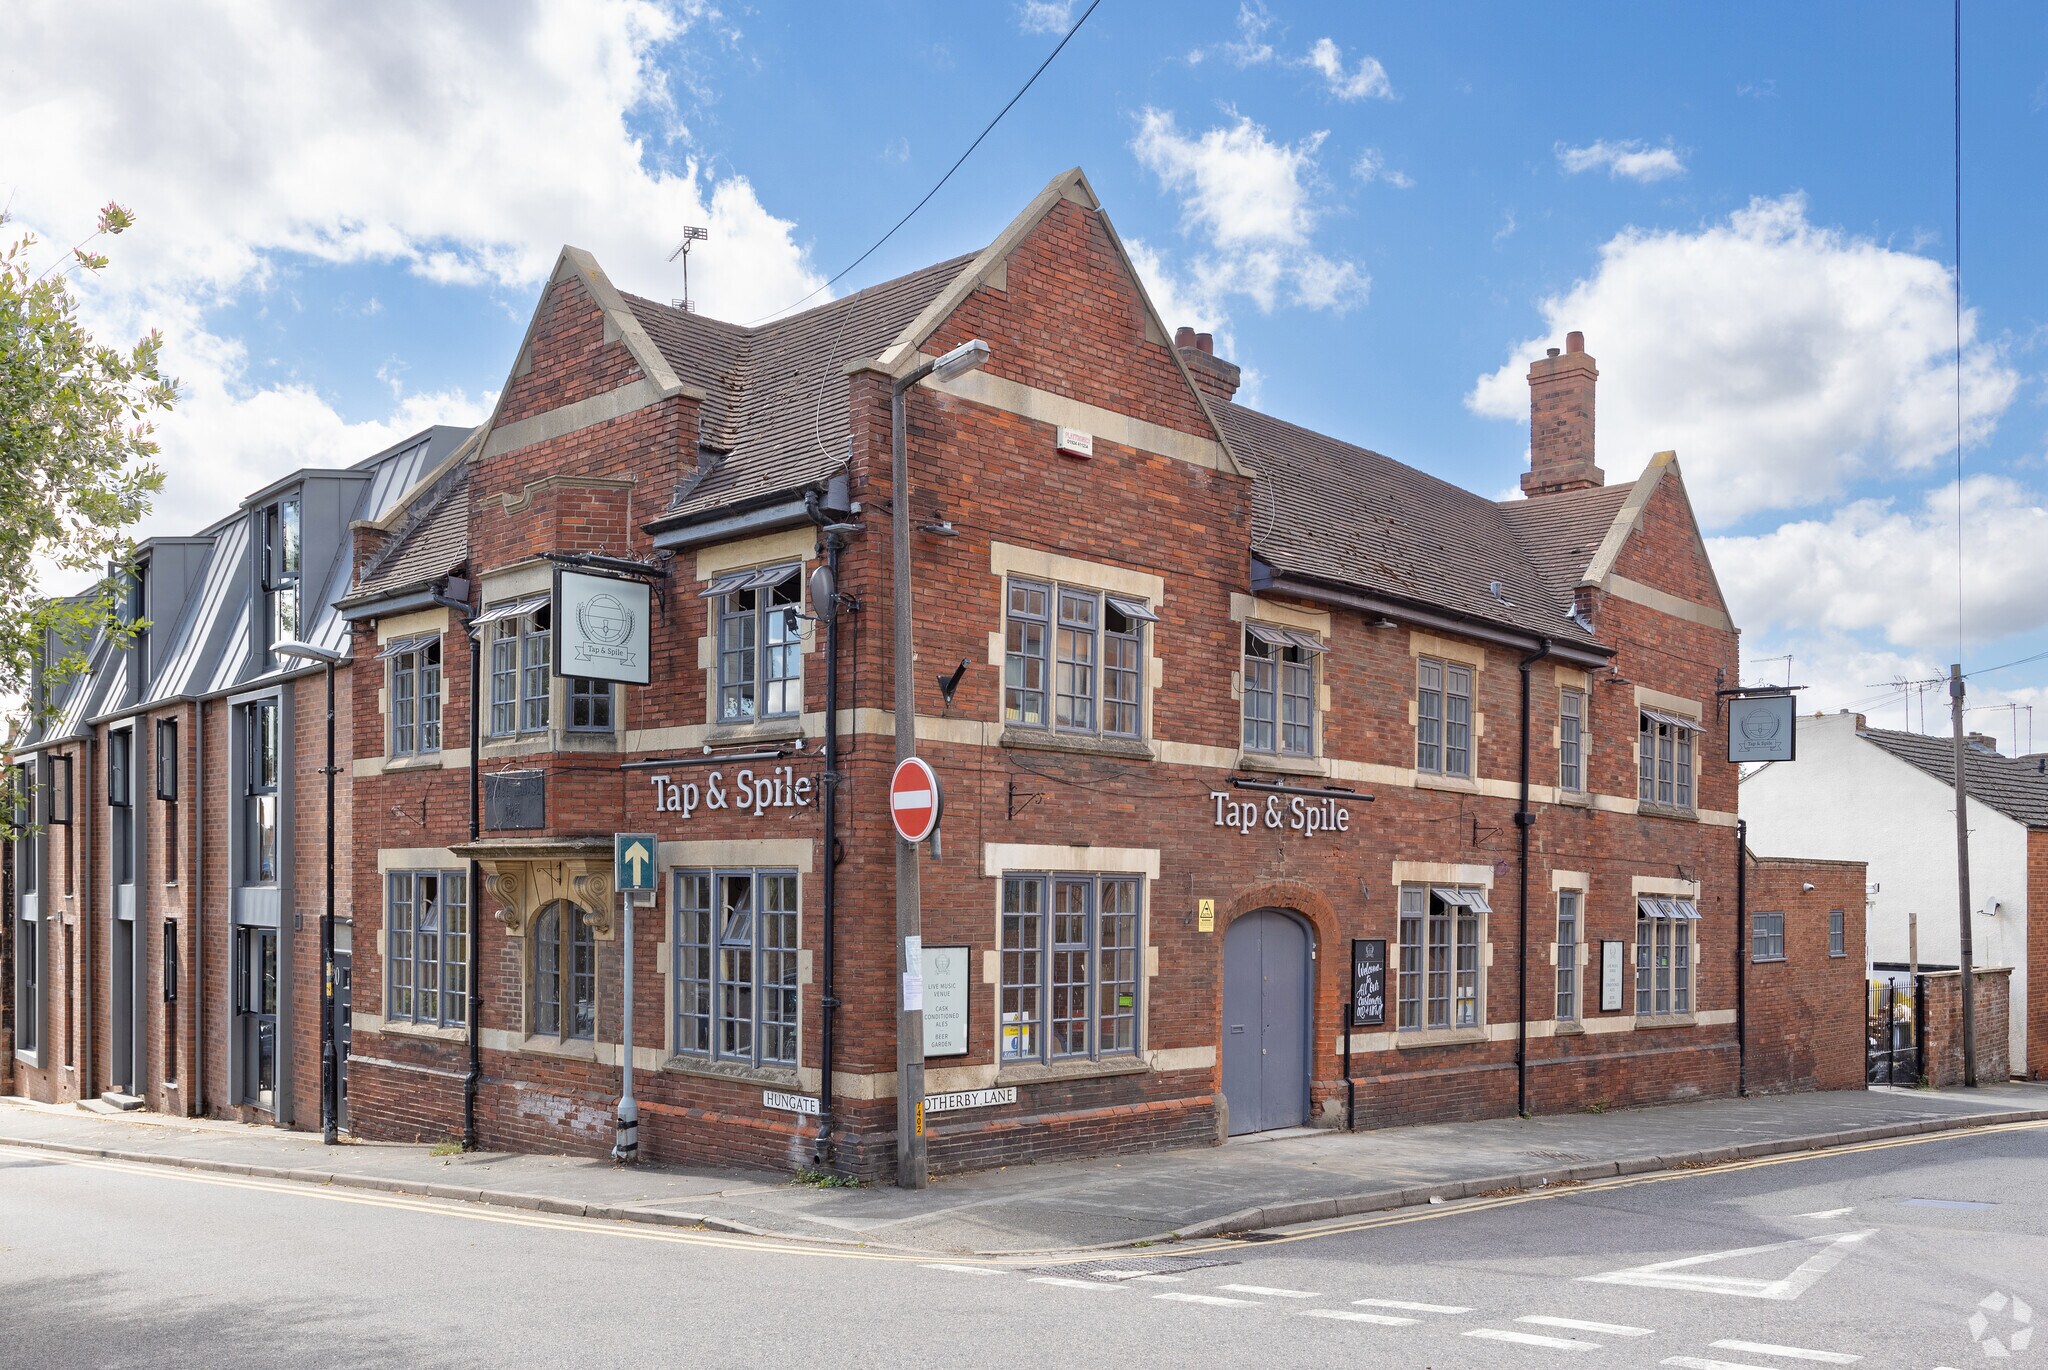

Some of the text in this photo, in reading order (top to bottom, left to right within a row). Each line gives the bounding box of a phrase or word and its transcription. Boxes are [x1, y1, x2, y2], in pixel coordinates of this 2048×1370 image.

[588, 645, 600, 655] Tap
[607, 647, 624, 656] Spile
[651, 766, 812, 819] Tap & Spile
[1209, 791, 1349, 837] Tap & Spile
[767, 1092, 816, 1112] HUNGATE
[924, 1089, 1013, 1111] OTHERBY LANE
